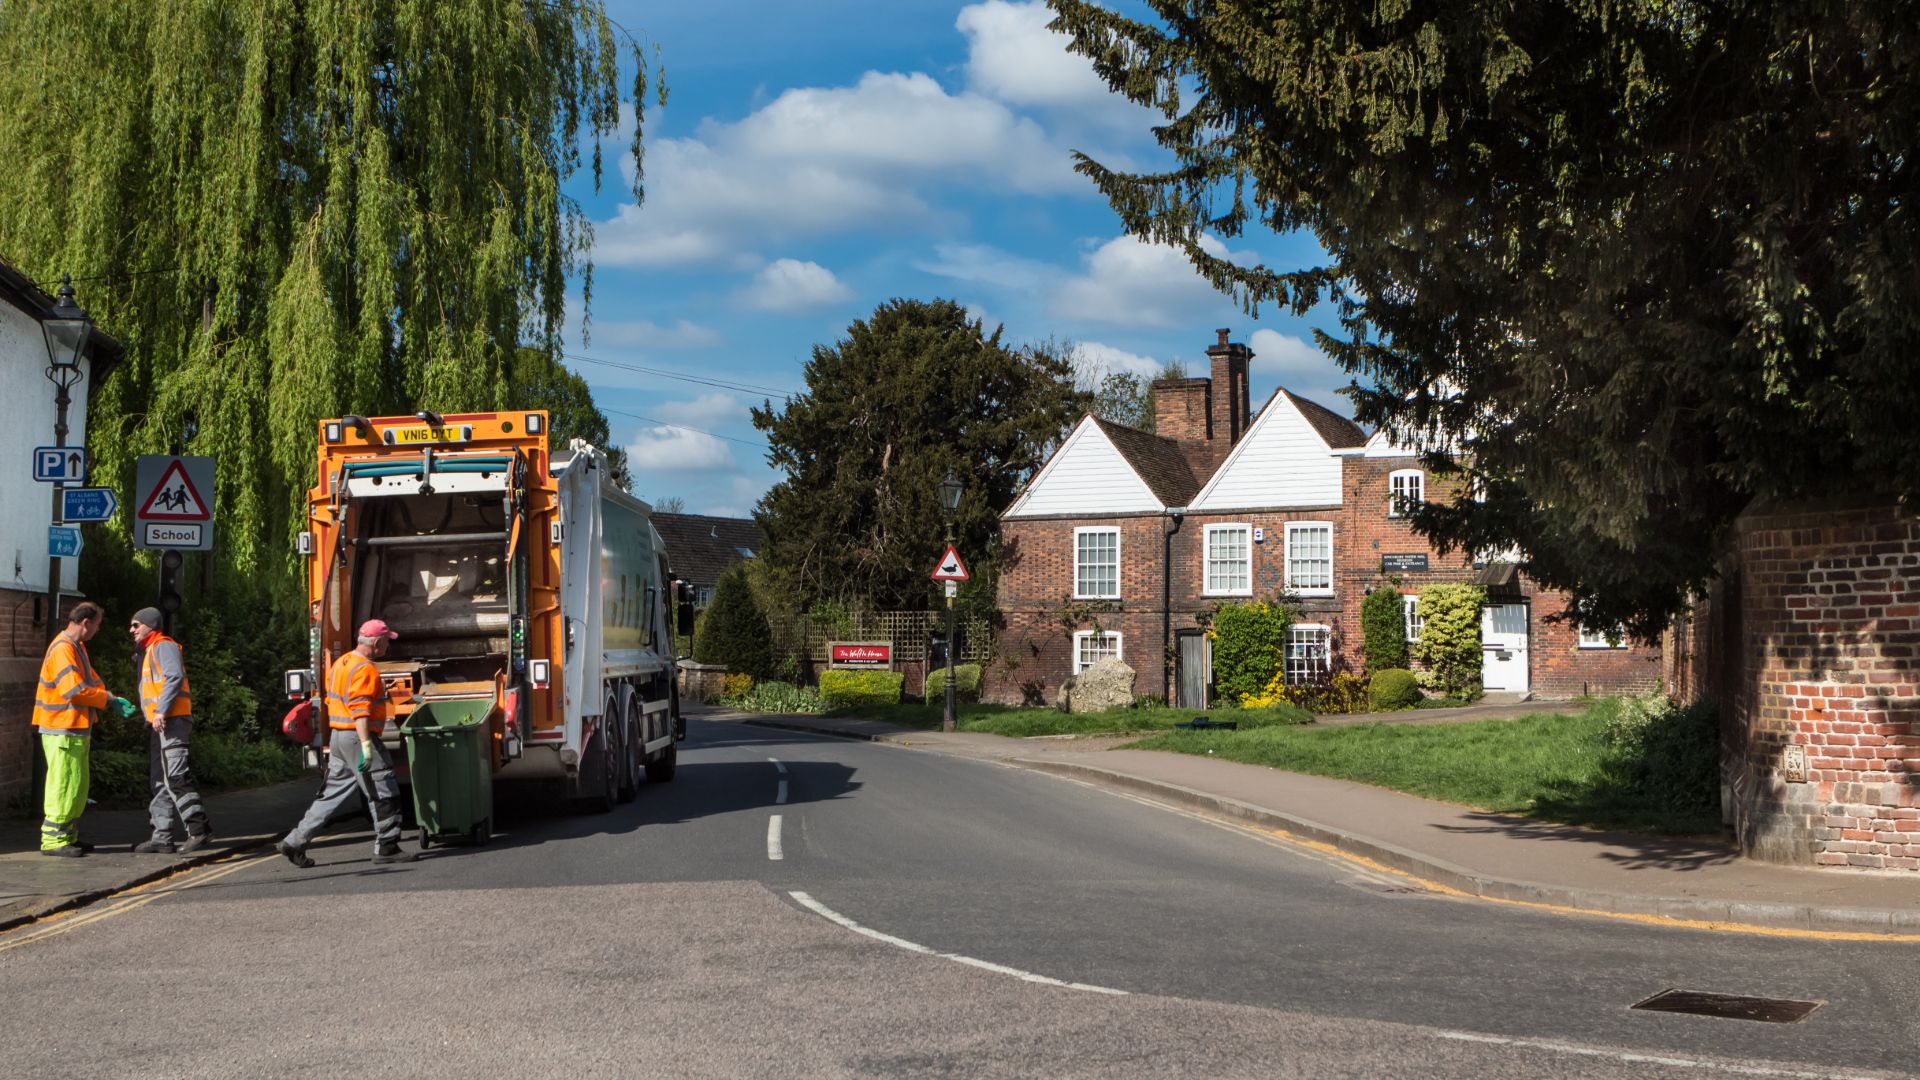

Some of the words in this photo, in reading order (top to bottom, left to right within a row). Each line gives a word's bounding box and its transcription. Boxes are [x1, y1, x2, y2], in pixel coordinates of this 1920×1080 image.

[403, 430, 428, 441] VN16
[43, 453, 61, 476] P
[152, 529, 196, 540] School
